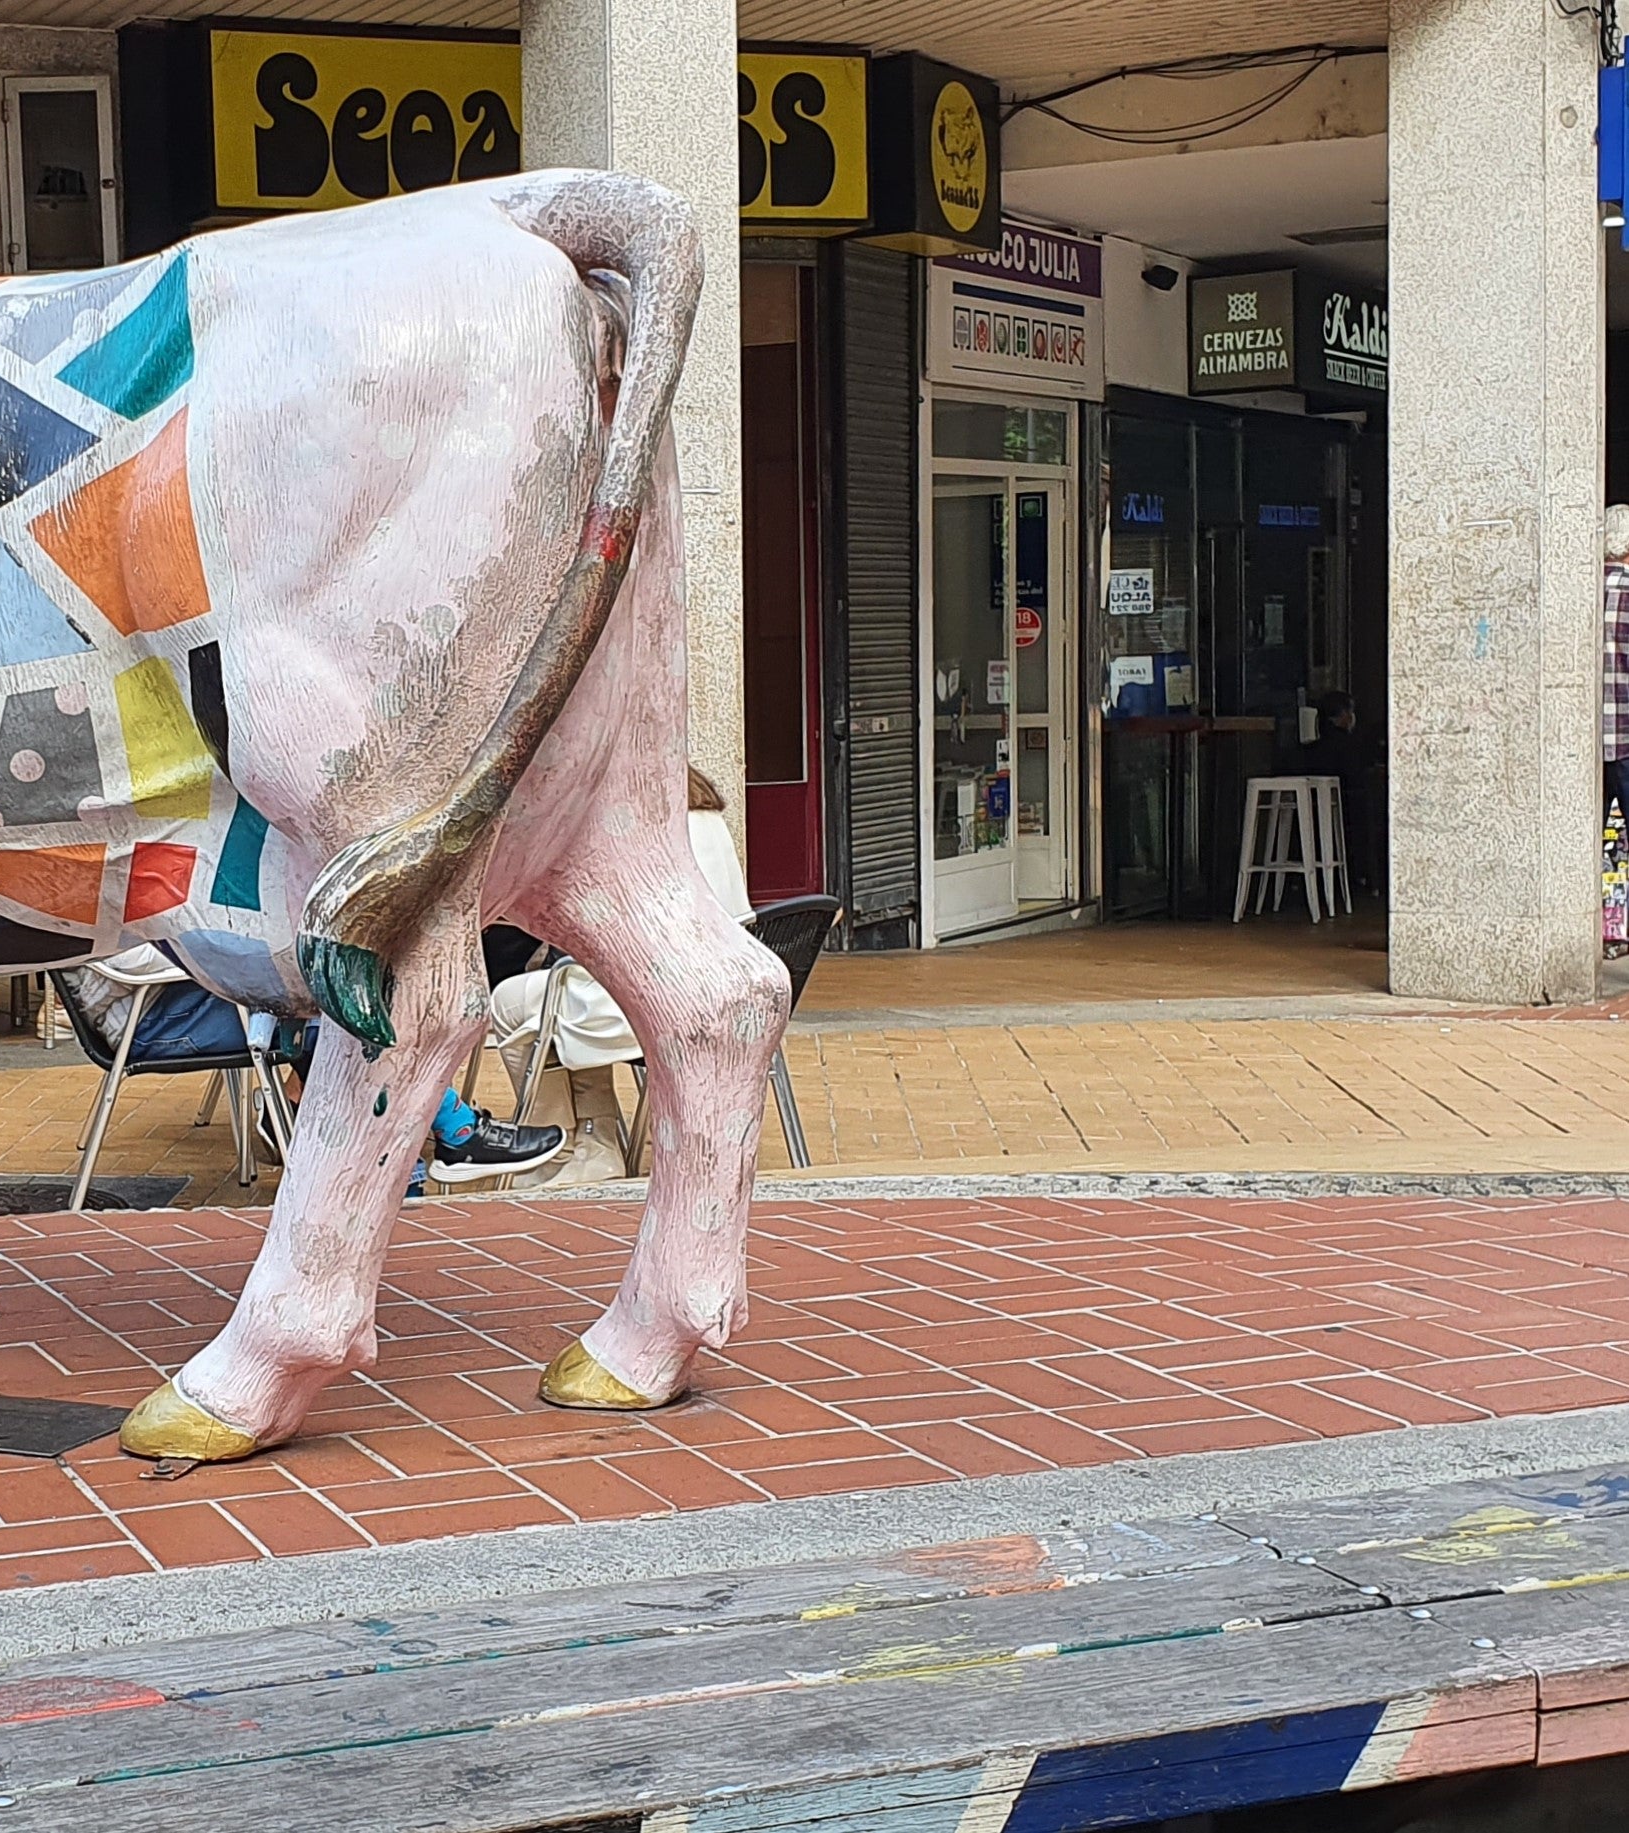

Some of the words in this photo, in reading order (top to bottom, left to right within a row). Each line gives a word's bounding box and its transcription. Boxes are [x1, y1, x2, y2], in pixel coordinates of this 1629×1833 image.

[1029, 237, 1081, 283] JULIA
[1203, 327, 1283, 353] CERVEZAS
[1323, 293, 1388, 358] Kaldi
[1198, 350, 1289, 375] ALHAMBRA
